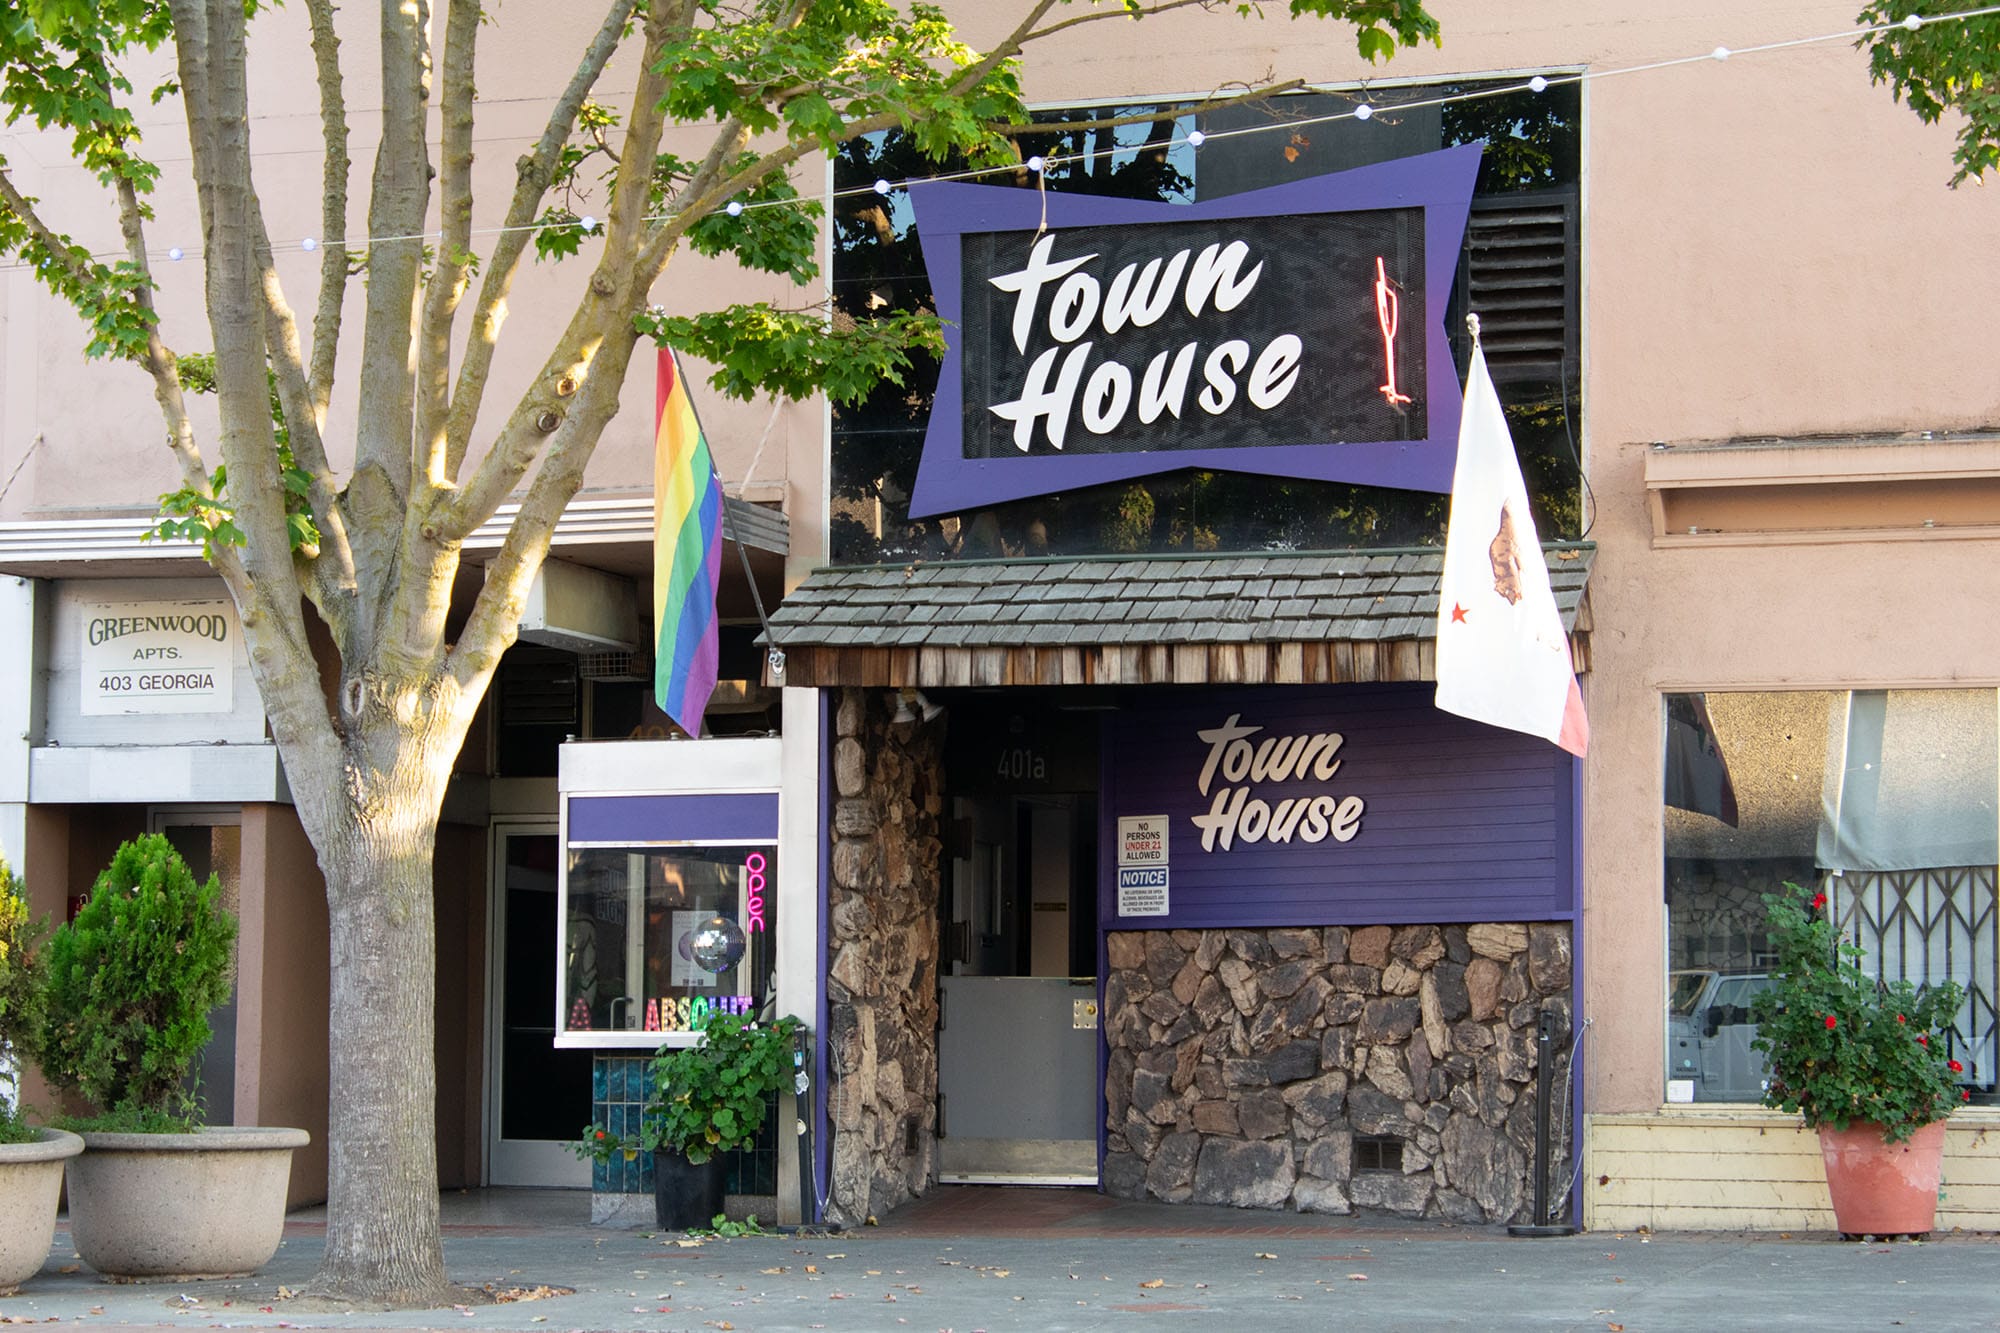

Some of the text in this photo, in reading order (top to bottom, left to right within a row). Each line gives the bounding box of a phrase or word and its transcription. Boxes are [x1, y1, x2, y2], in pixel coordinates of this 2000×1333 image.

[89, 615, 227, 646] GREENWOOD
[133, 647, 182, 660] APTS.
[99, 674, 214, 691] 403 GEORGIA
[998, 750, 1045, 779] 401a
[1138, 822, 1149, 831] NO
[1126, 831, 1160, 841] PERSONS
[1125, 841, 1162, 850] UNDER 21
[1126, 851, 1161, 860] ALLOWED
[1121, 871, 1166, 886] NOTICE
